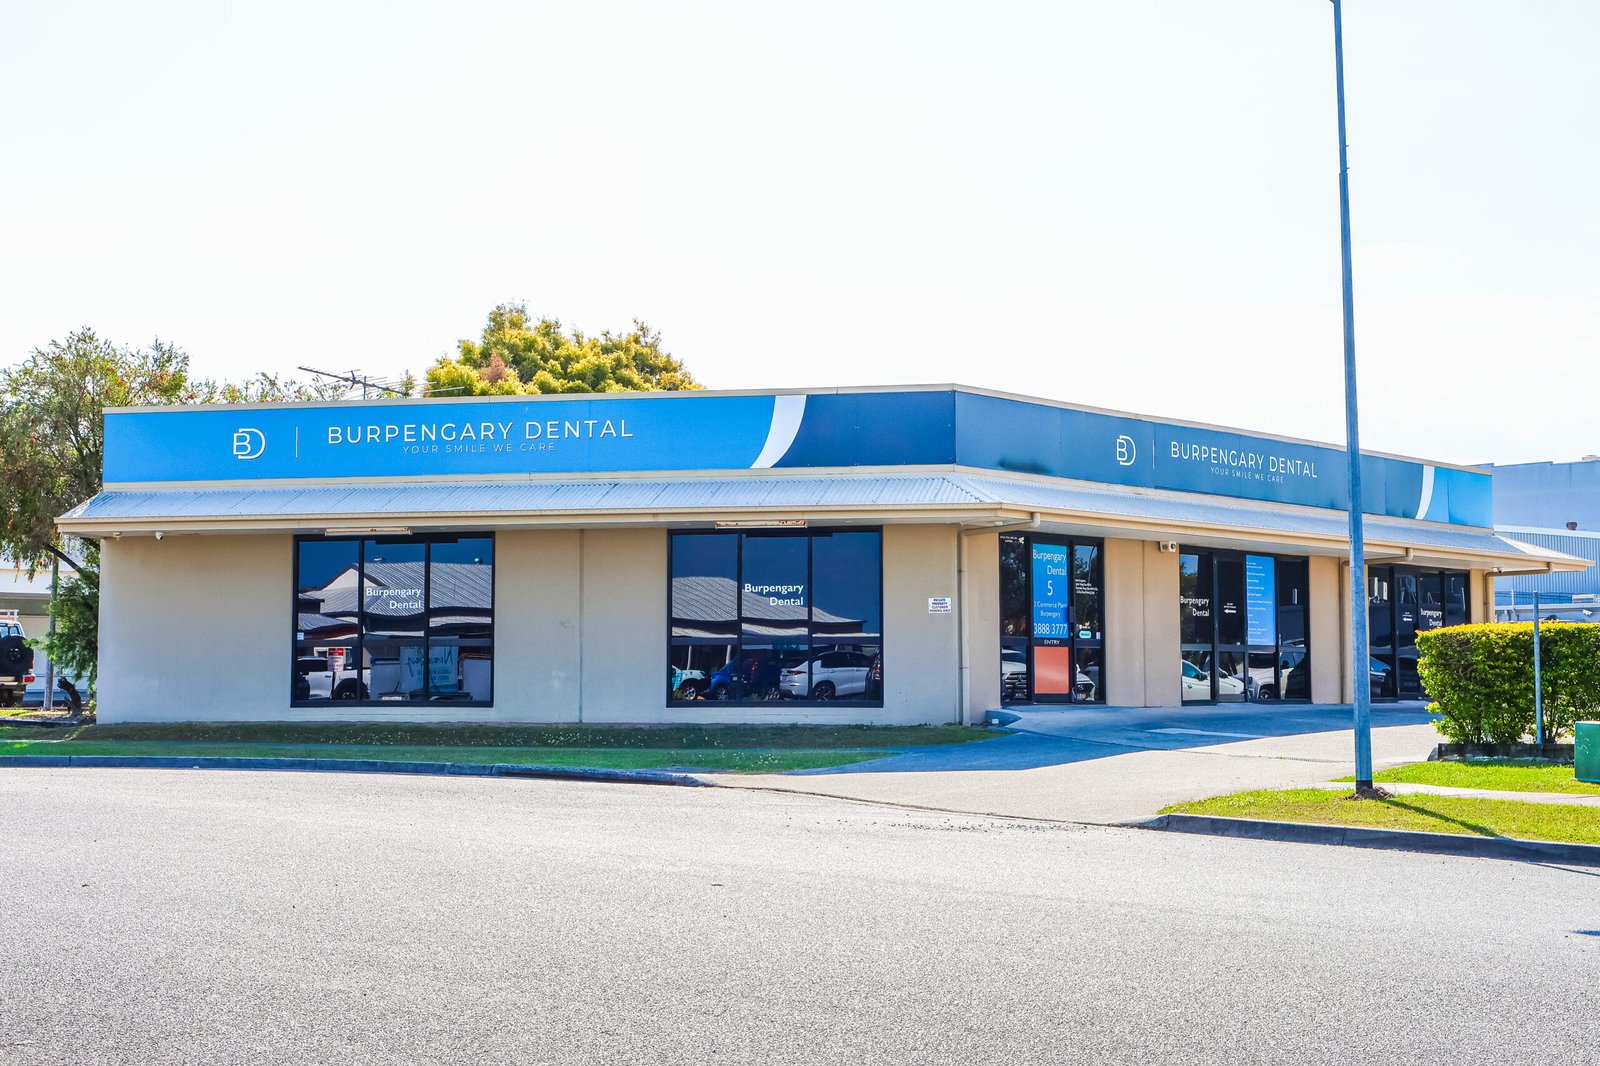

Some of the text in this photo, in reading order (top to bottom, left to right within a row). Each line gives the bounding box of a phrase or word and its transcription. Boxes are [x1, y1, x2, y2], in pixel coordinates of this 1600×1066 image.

[328, 419, 635, 444] BURPENGARY DENTAL
[403, 443, 556, 454] YOUR SMILE WE CARE
[1171, 441, 1318, 478] BURPENGARY DENTAL
[1210, 466, 1285, 484] YOUR SMILE WE CARE
[1033, 549, 1066, 564] Burpengary
[1047, 565, 1067, 576] Dental
[366, 587, 421, 598] Burpengary
[744, 583, 804, 595] Burpengary
[1047, 580, 1054, 596] 5
[389, 600, 421, 609] Dental
[770, 596, 804, 606] Dental
[1180, 596, 1209, 606] Burpengary
[1033, 623, 1050, 635] 3888
[1051, 623, 1068, 635] 3777
